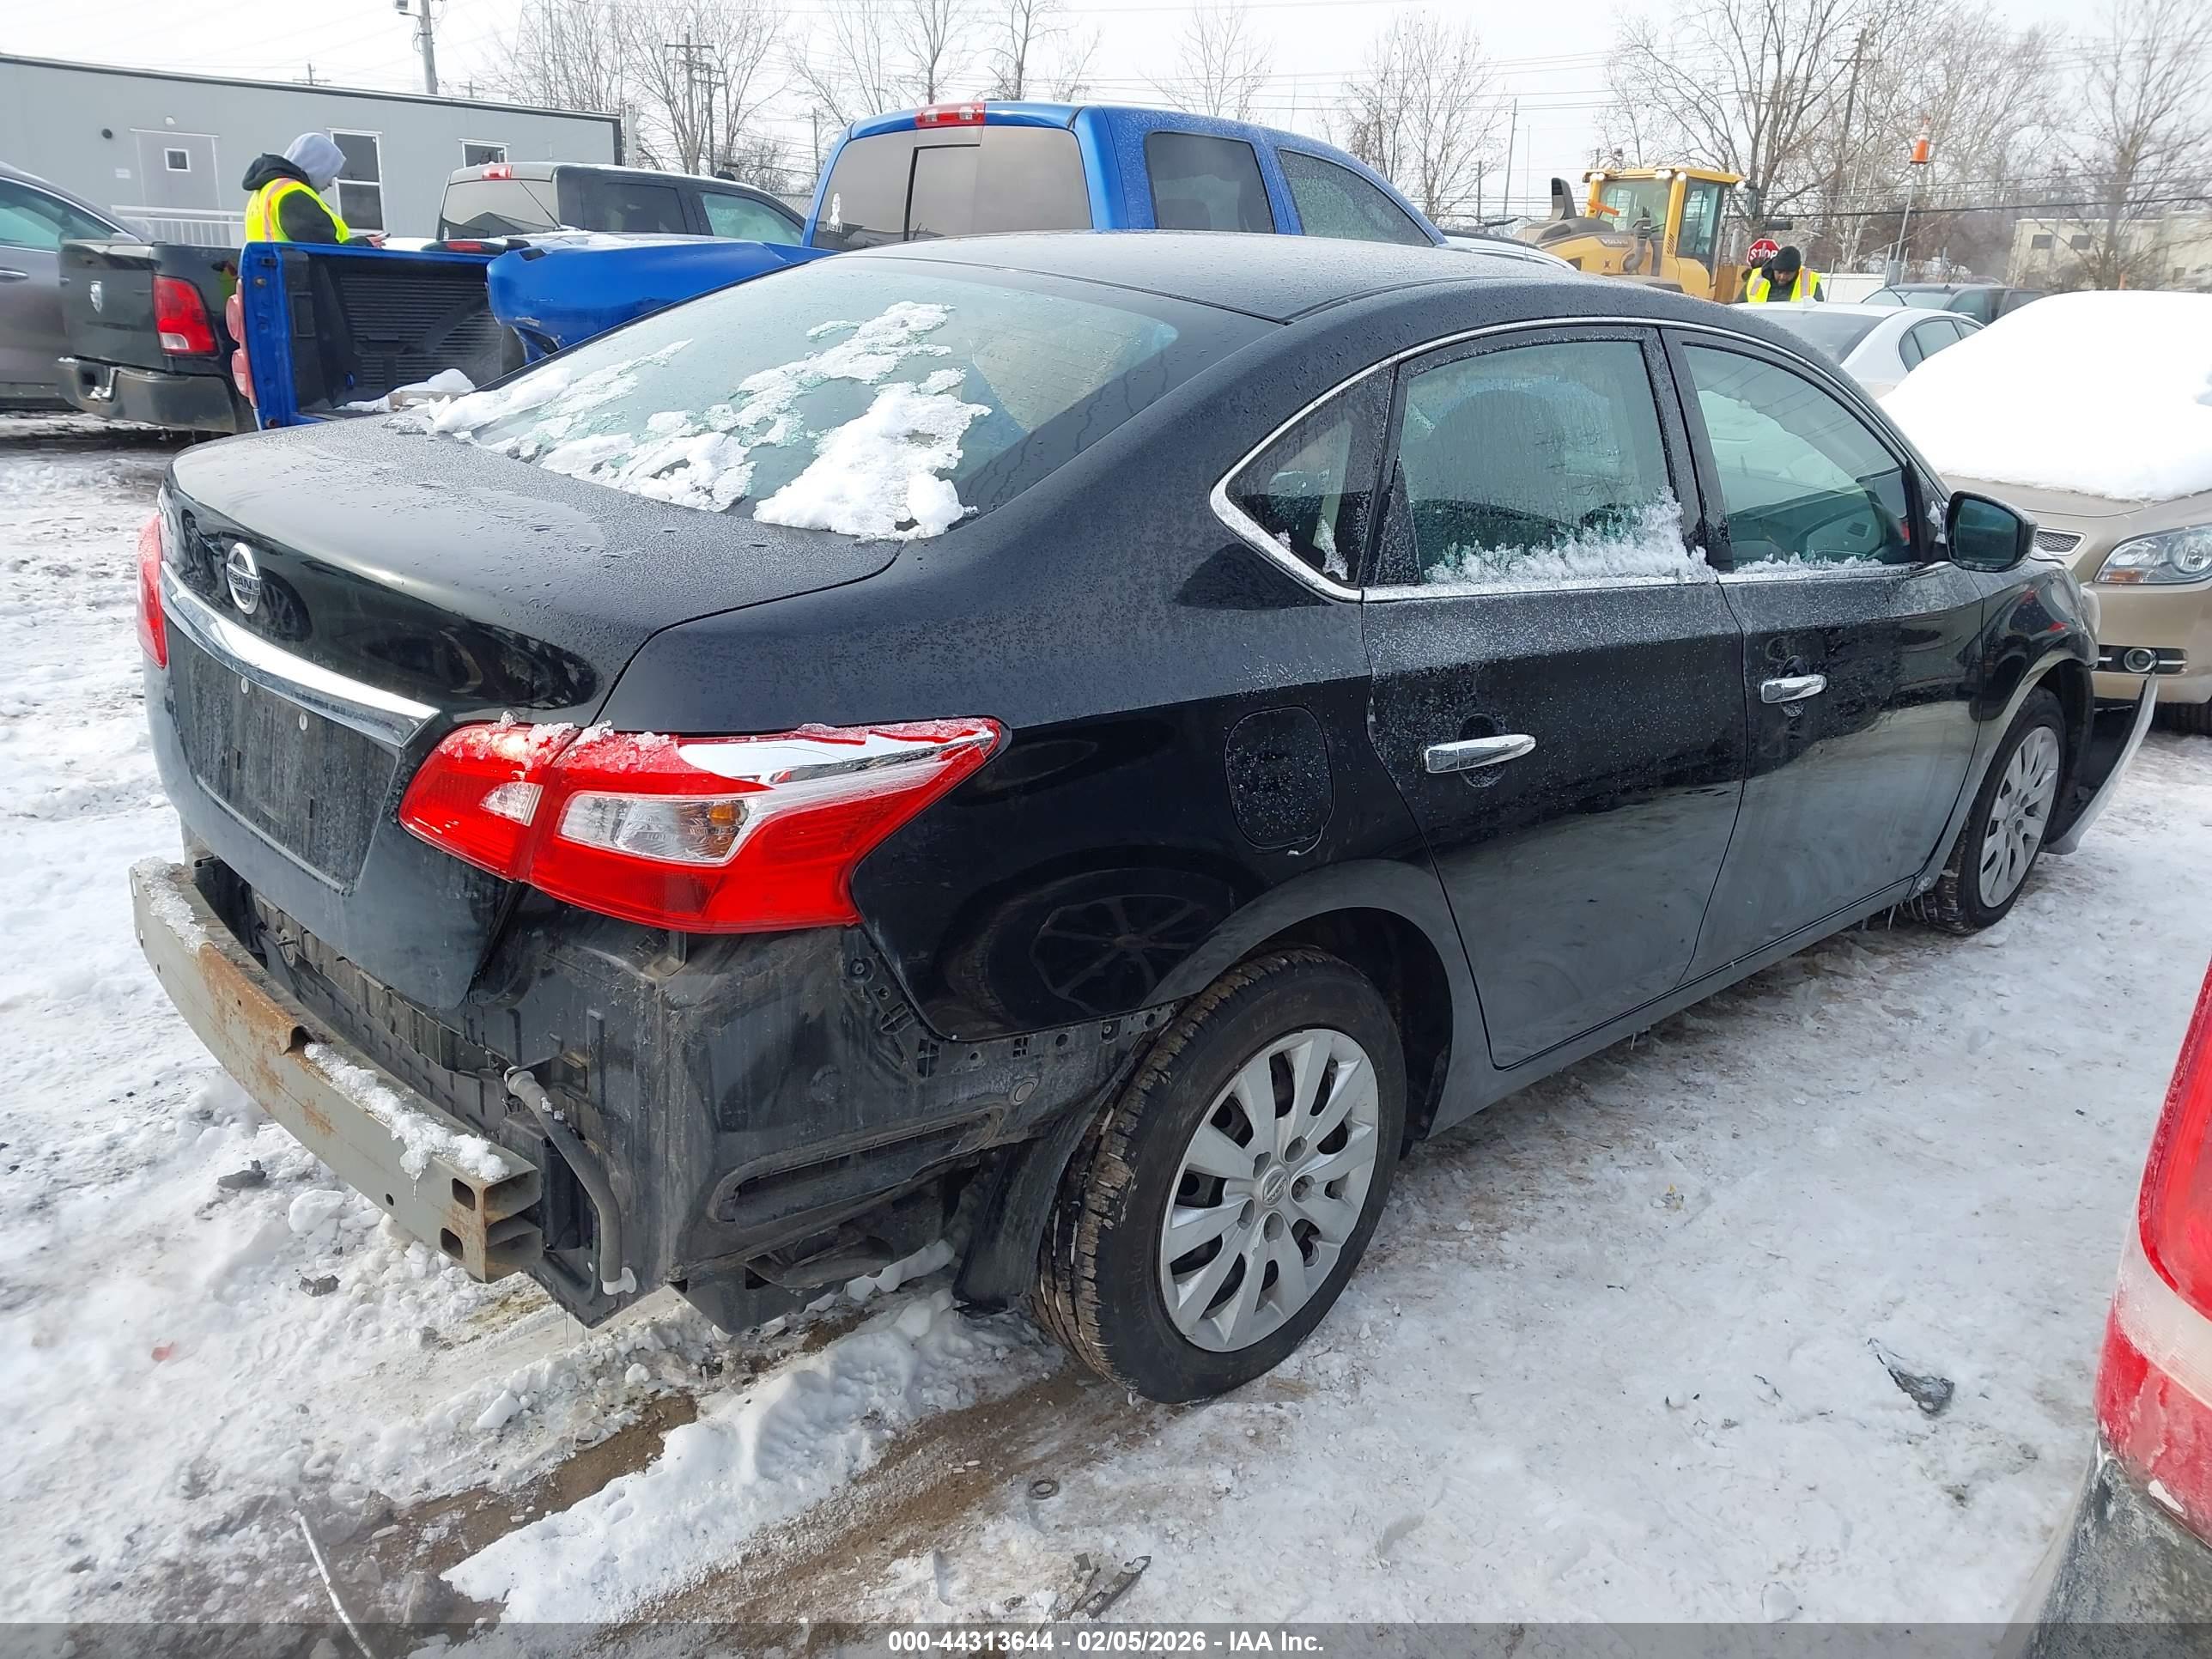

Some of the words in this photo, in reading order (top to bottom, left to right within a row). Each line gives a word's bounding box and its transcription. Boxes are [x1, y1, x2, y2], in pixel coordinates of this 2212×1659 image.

[1750, 248, 1778, 260] STOP
[227, 568, 253, 591] SSAN
[1267, 1176, 1287, 1203] NISSAN
